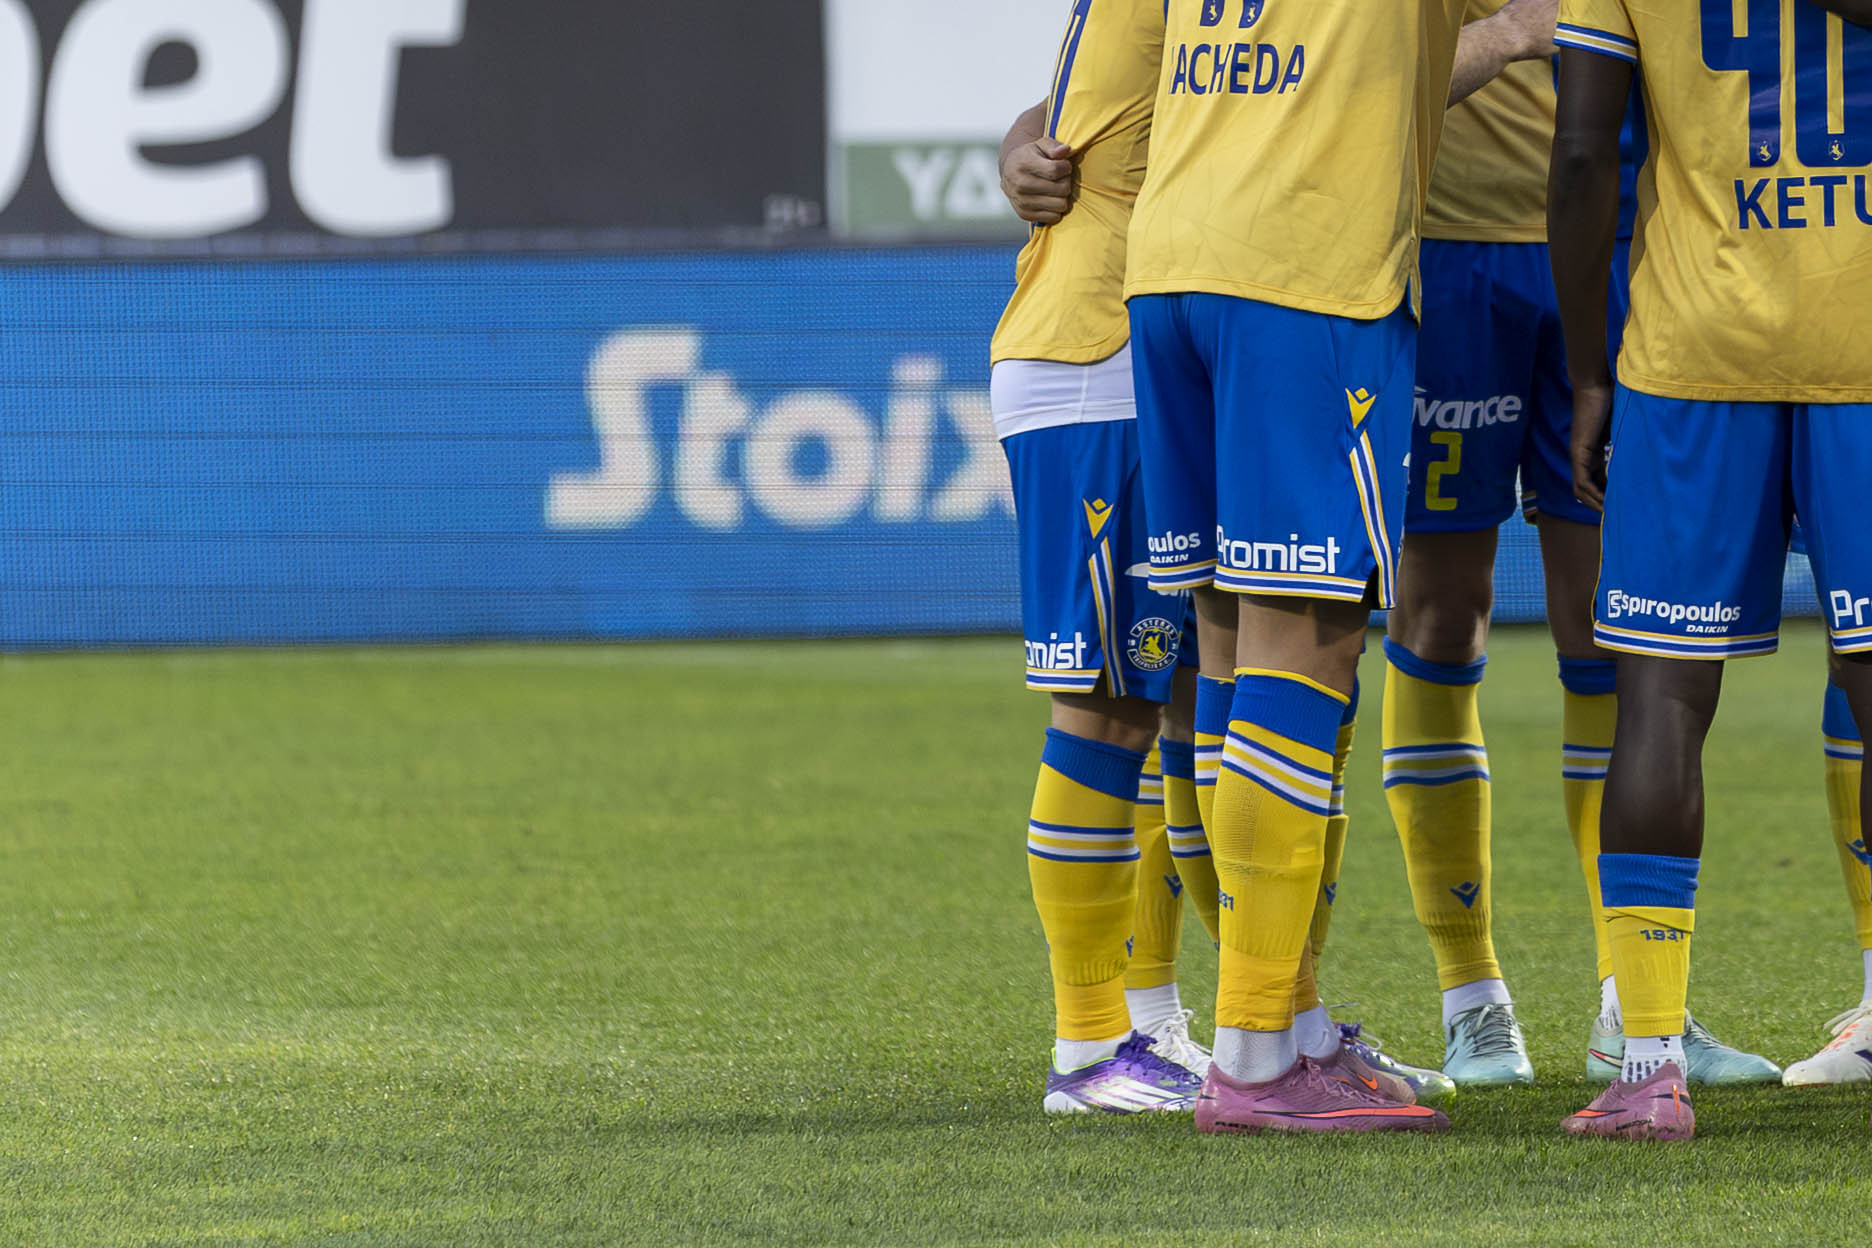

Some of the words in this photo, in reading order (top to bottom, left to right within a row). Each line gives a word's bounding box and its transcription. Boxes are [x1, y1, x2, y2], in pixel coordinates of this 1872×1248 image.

[1168, 43, 1305, 95] ACHEDA
[1412, 395, 1522, 429] vance
[1425, 432, 1463, 511] 2
[1216, 524, 1340, 574] Promist
[1621, 593, 1742, 624] spiropoulos
[1685, 624, 1729, 633] DAIKIN
[1640, 929, 1685, 942] 1931
